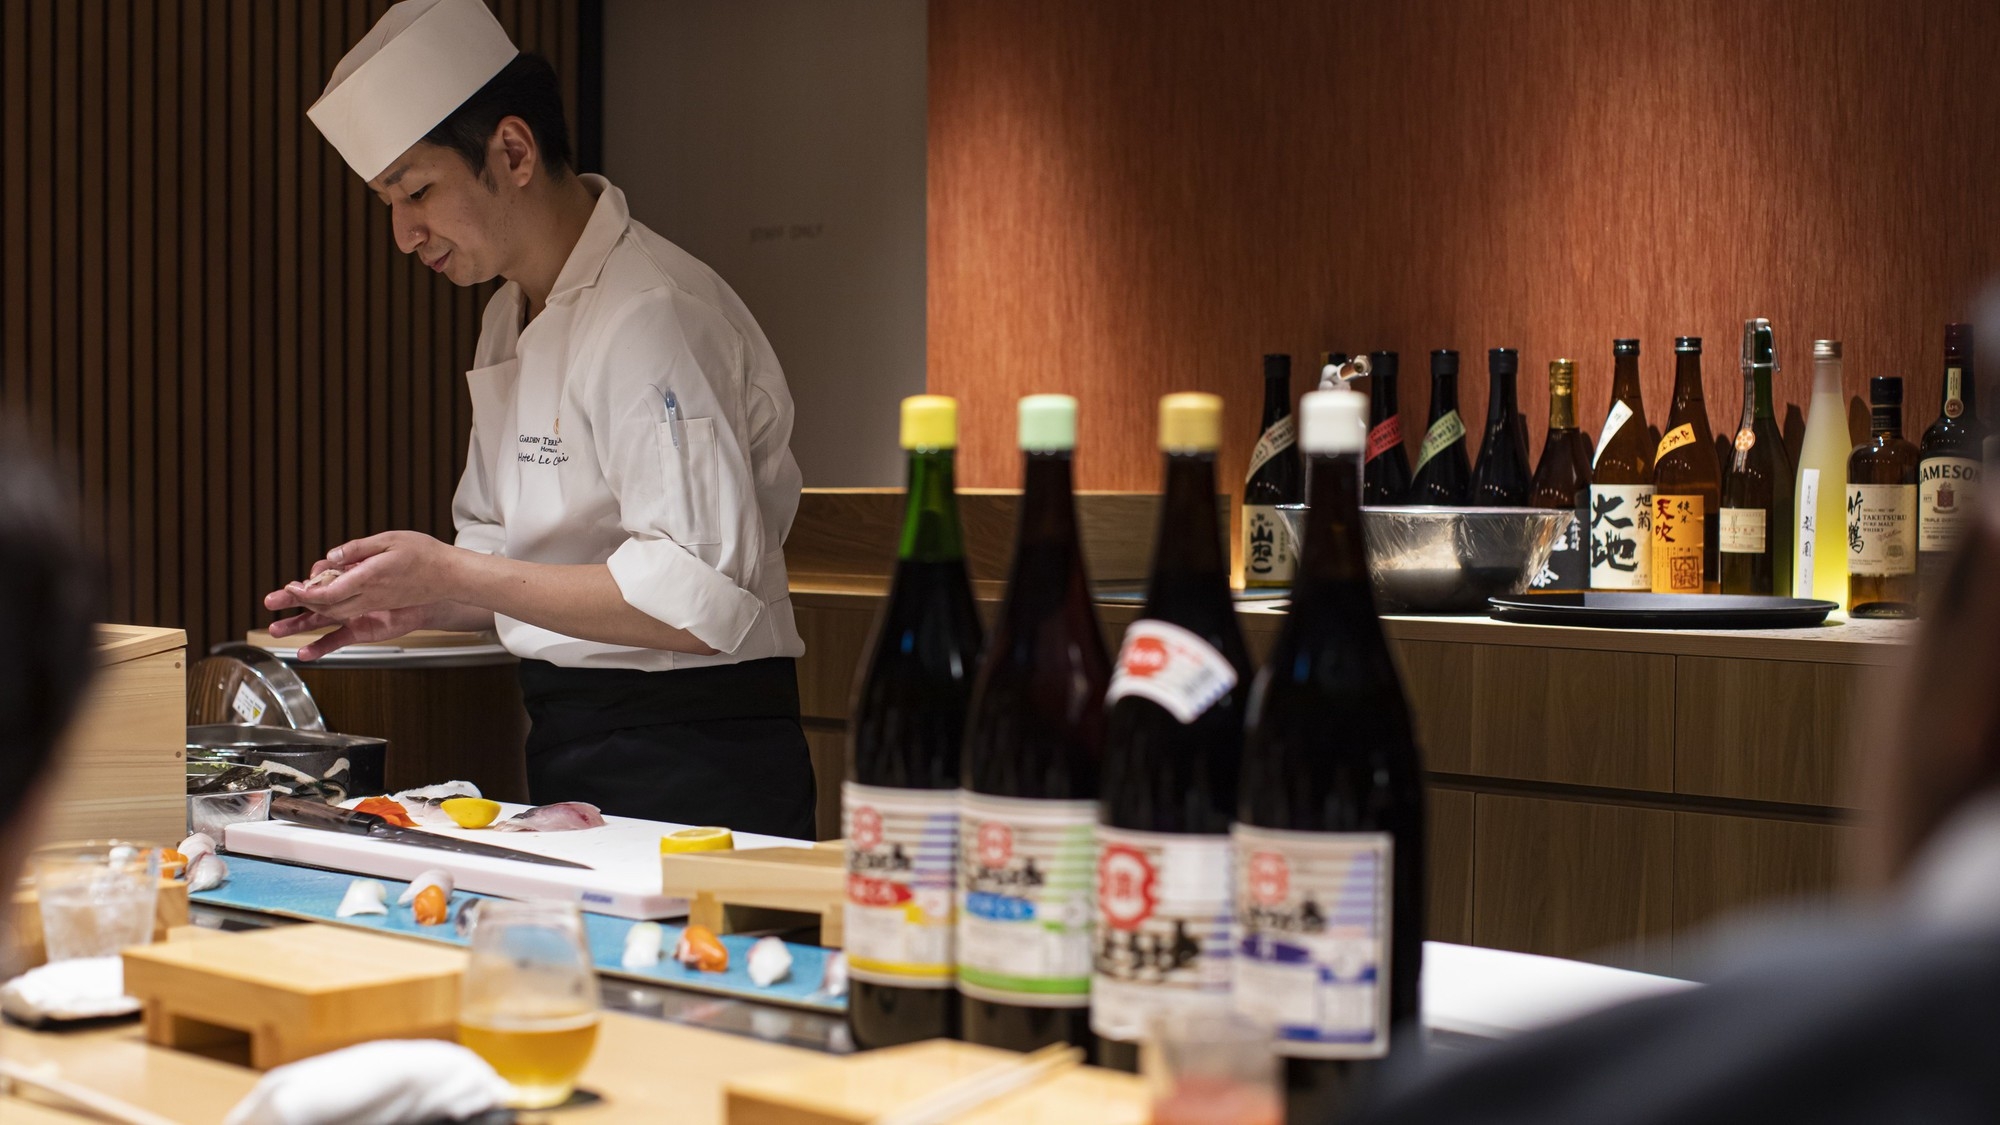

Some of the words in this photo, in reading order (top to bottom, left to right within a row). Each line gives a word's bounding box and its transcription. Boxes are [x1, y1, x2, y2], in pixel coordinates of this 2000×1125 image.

[538, 454, 552, 465] Le
[1592, 493, 1639, 572] 大地
[1655, 498, 1675, 543] 天吹
[1251, 525, 1273, 574] 山ねこ
